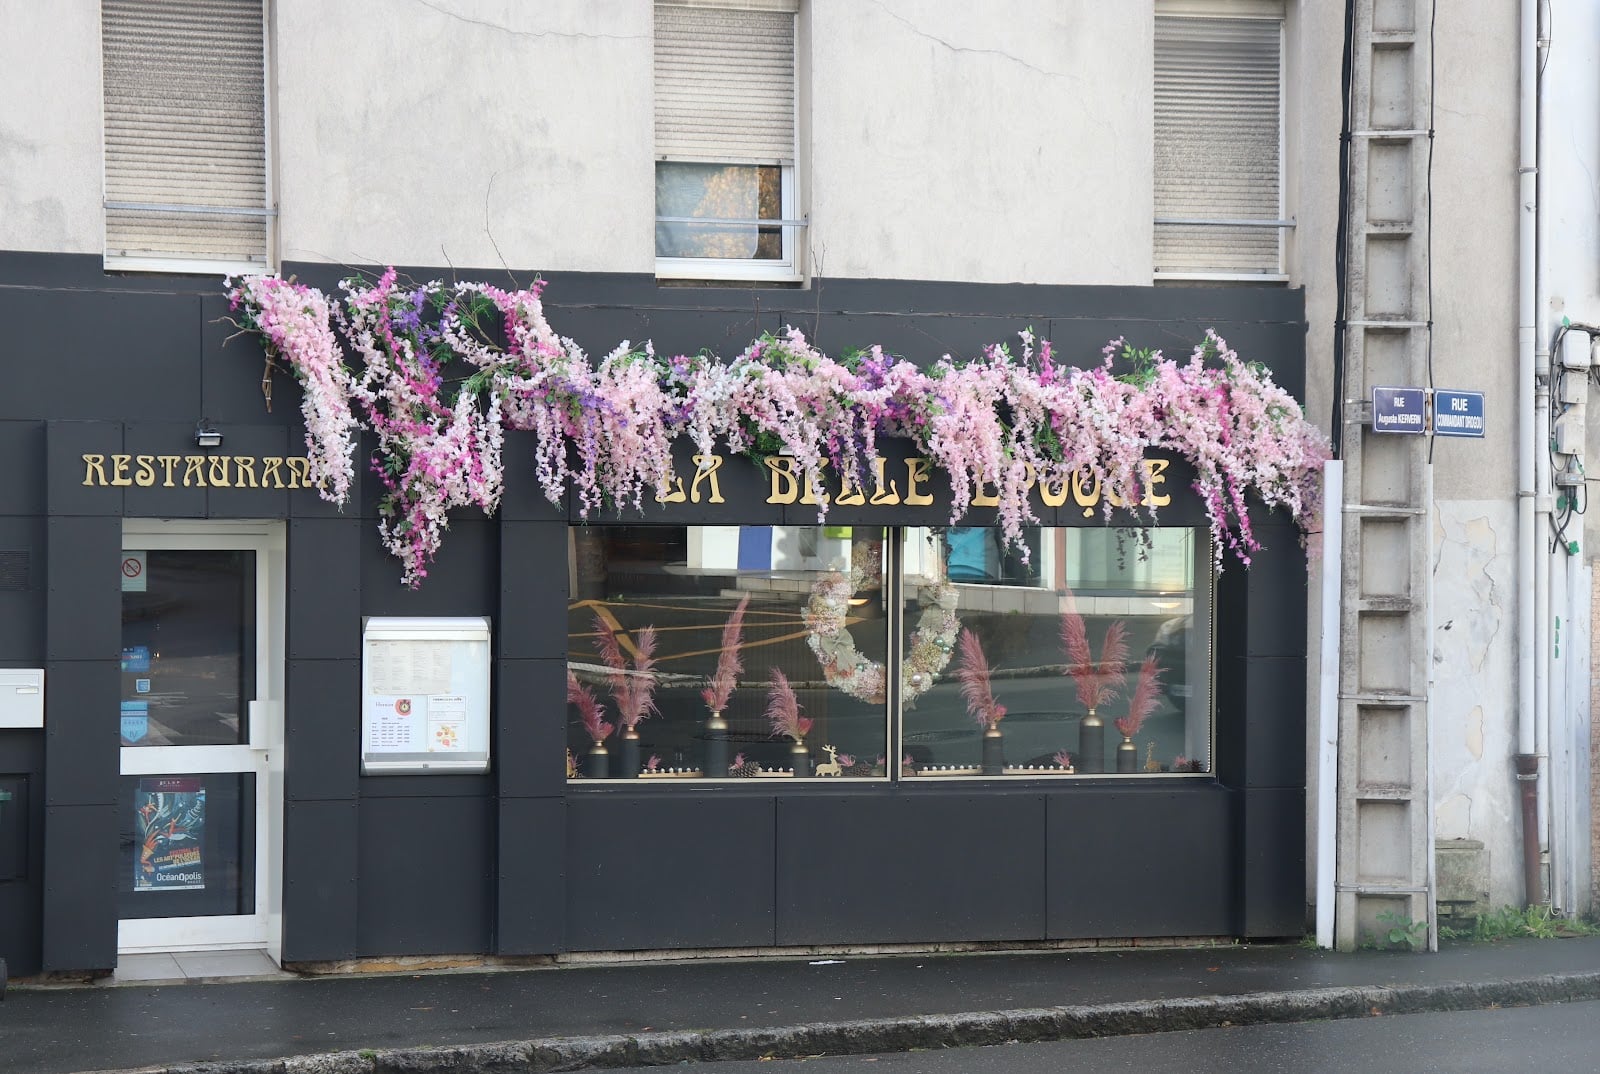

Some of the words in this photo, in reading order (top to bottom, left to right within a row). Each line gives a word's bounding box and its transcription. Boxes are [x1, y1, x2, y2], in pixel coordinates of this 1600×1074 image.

[1393, 397, 1405, 408] RUE
[1451, 397, 1468, 411] RUE
[1437, 413, 1465, 428] COMMANDANT
[655, 454, 725, 503] LA
[764, 455, 934, 506] BELLE
